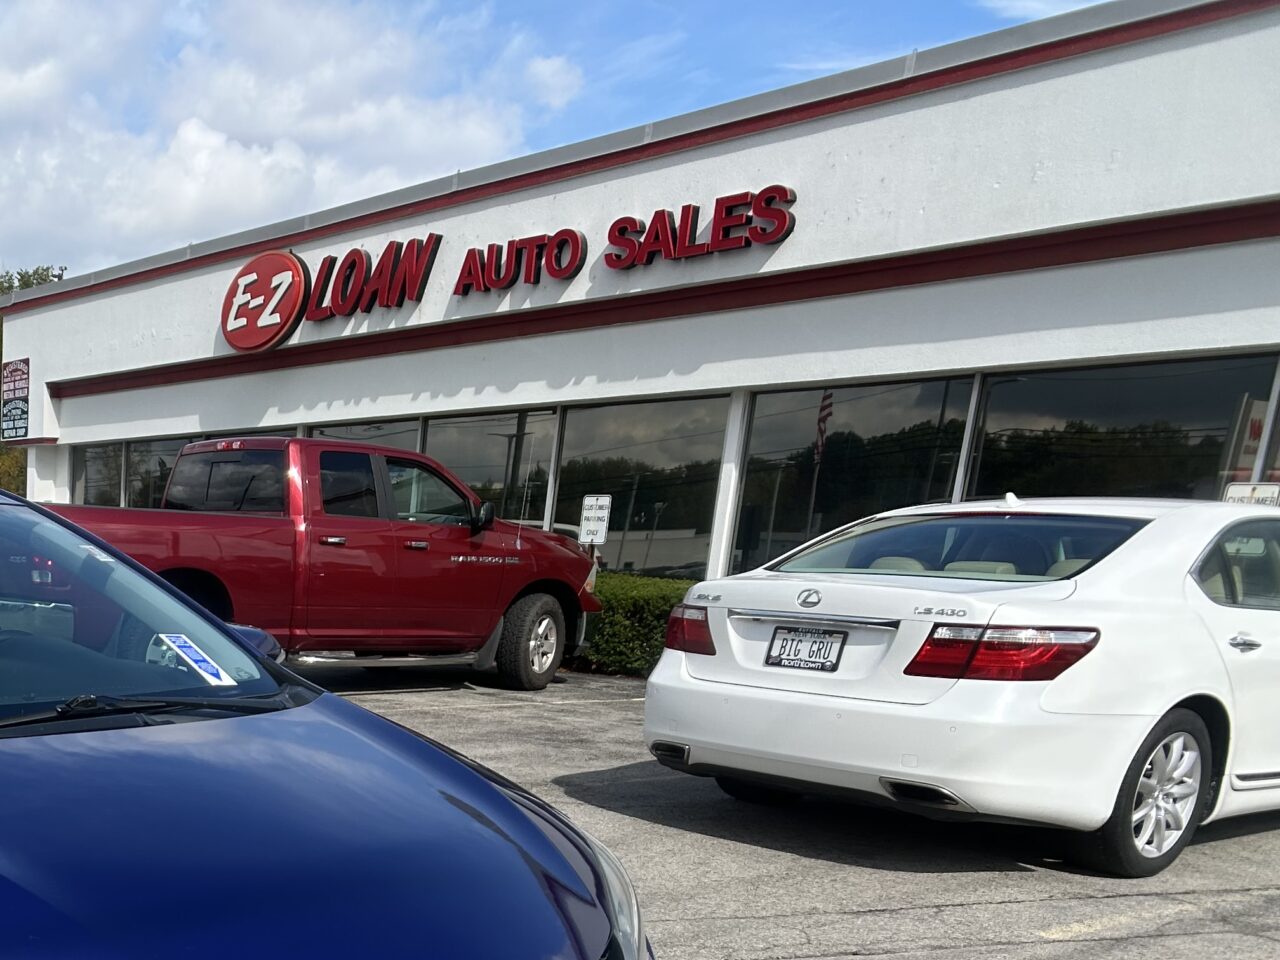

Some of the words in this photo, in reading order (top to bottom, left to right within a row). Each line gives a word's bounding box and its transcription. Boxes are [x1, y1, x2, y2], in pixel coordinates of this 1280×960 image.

[226, 269, 294, 333] E-Z
[306, 231, 443, 322] LOAN
[454, 228, 587, 297] AUTO
[604, 184, 797, 270] SALES
[780, 638, 803, 657] BIG
[808, 640, 834, 660] GRU
[781, 658, 822, 670] northtown
